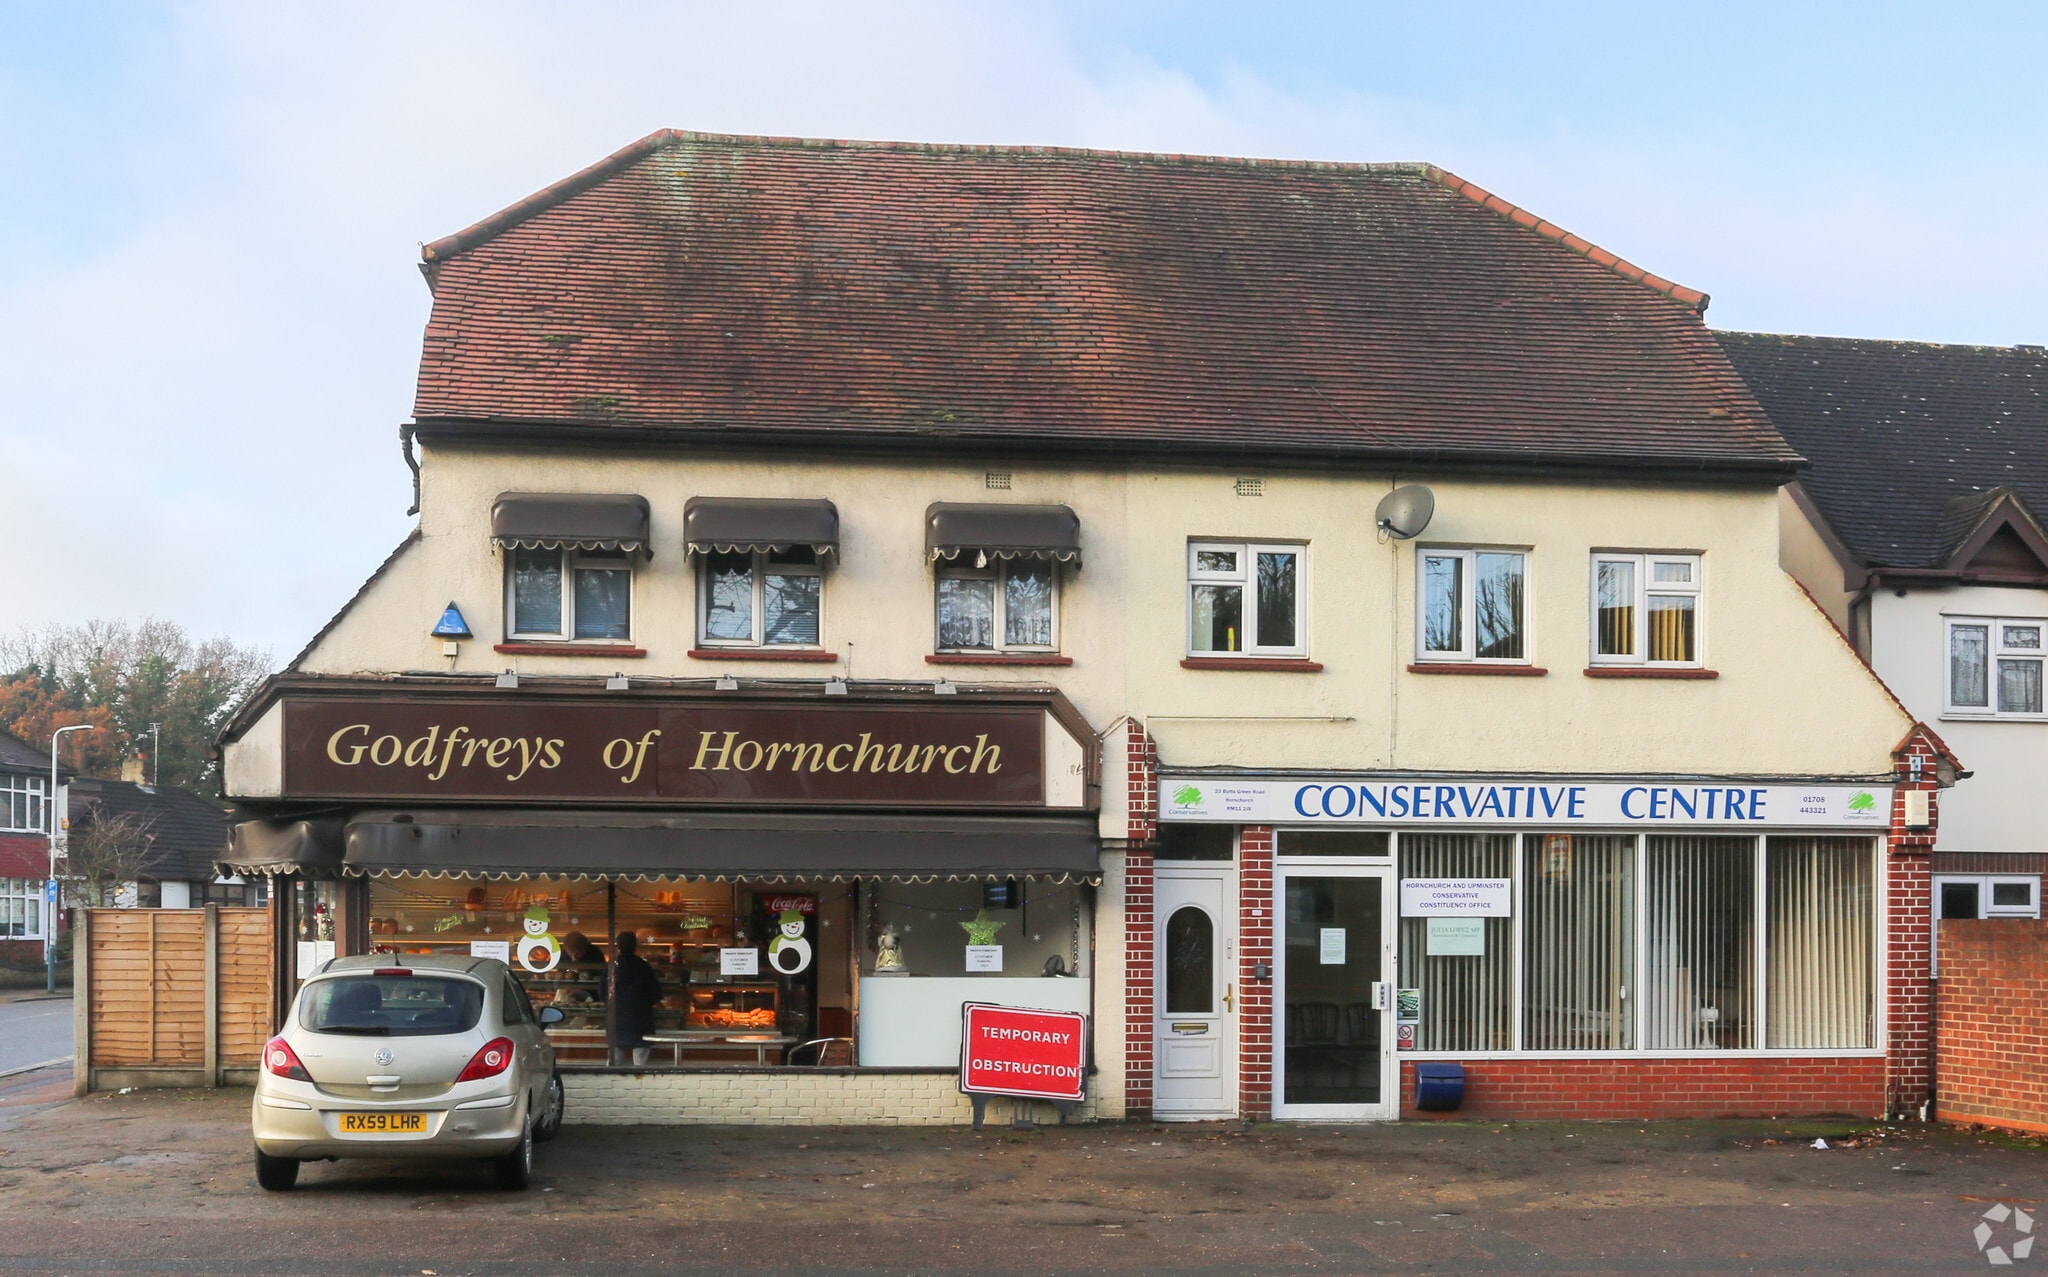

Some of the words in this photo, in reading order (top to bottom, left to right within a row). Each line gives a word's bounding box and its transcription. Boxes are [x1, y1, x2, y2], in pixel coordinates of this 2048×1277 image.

[326, 724, 565, 781] Godfreys
[602, 729, 662, 783] of
[688, 731, 1002, 774] Hornchurch
[1294, 785, 1586, 819] CONSERVATIVE
[1620, 787, 1768, 820] CENTRE
[981, 1026, 1070, 1044] TEMPORARY
[972, 1058, 1077, 1078] OBSTRUCTION
[346, 1115, 387, 1130] RX59
[390, 1115, 420, 1130] LHR
